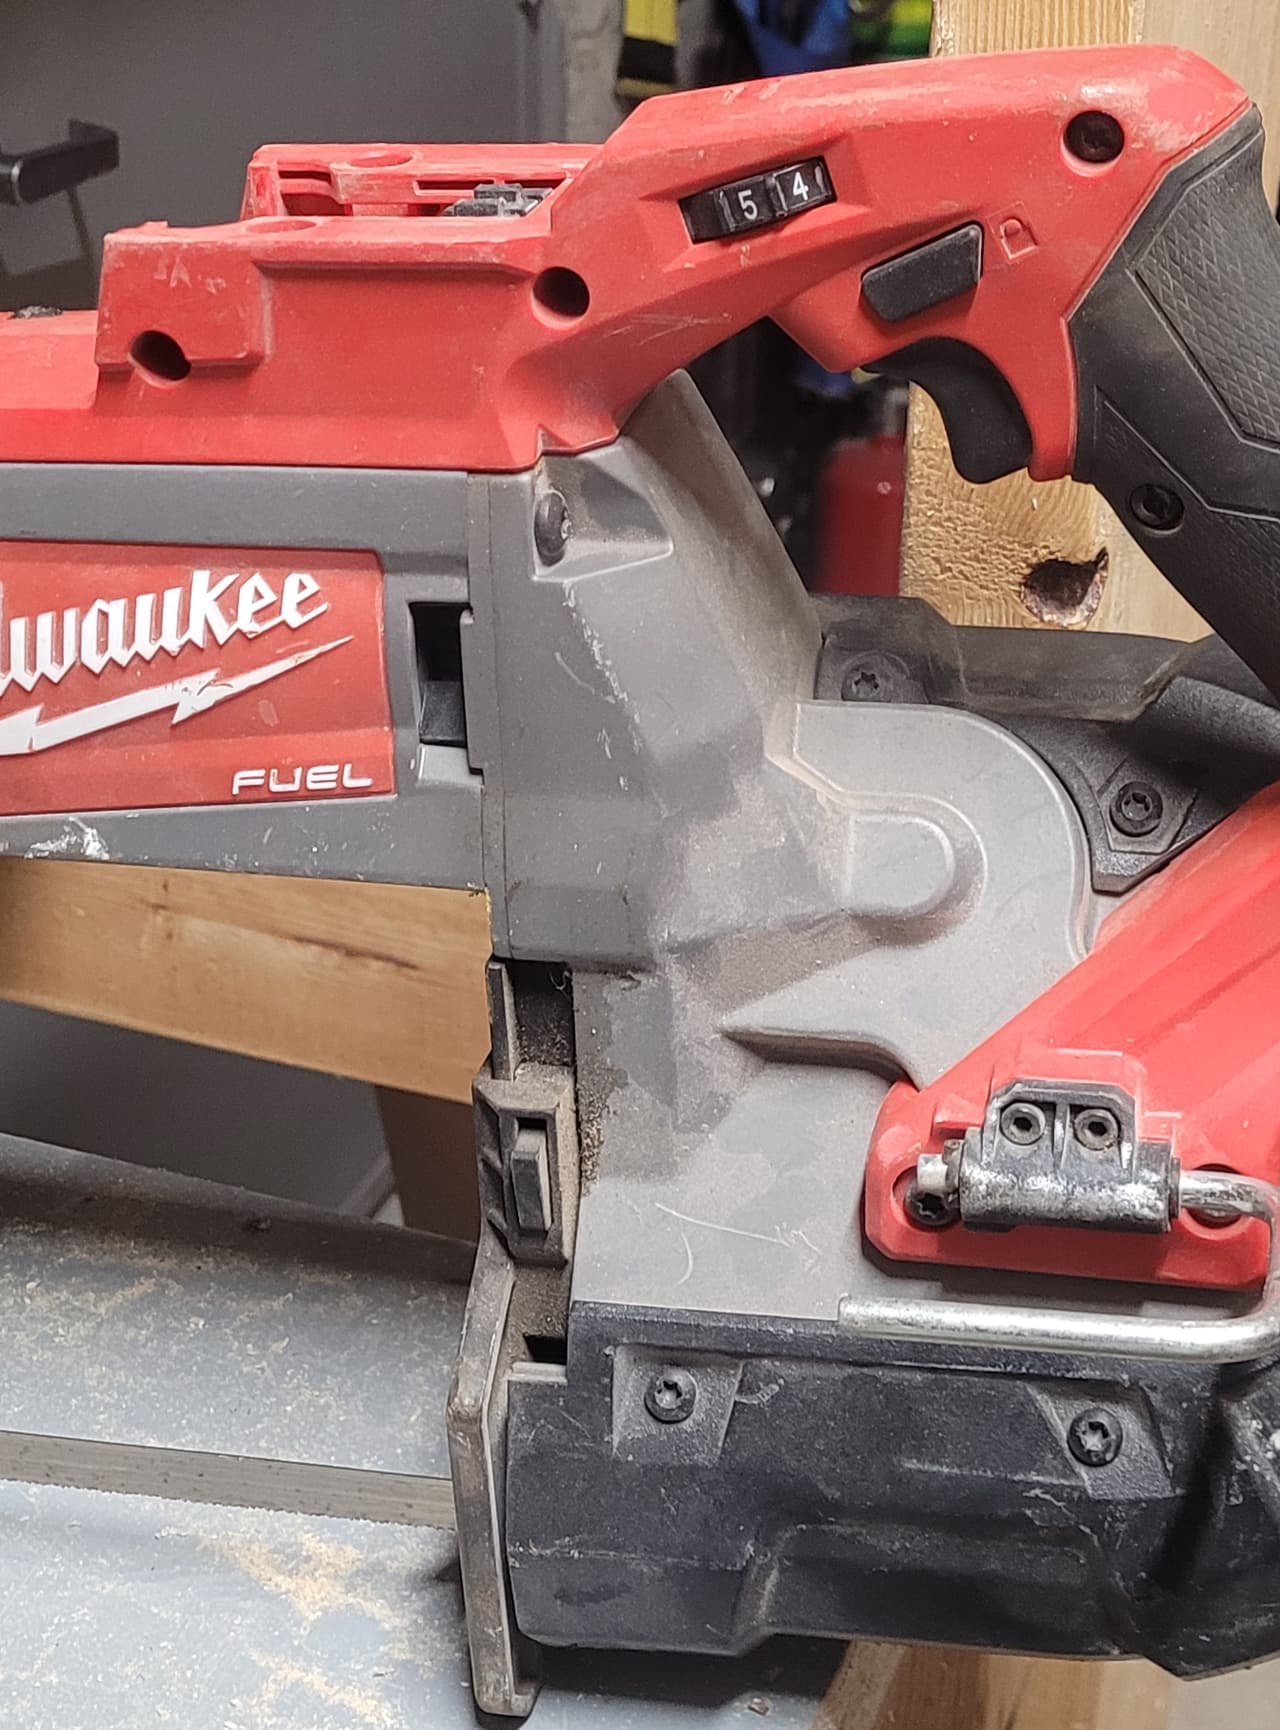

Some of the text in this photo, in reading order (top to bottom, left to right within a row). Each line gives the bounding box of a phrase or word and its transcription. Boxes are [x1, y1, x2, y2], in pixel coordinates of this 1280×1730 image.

[738, 171, 810, 221] 5 4
[232, 763, 373, 795] FUEL
